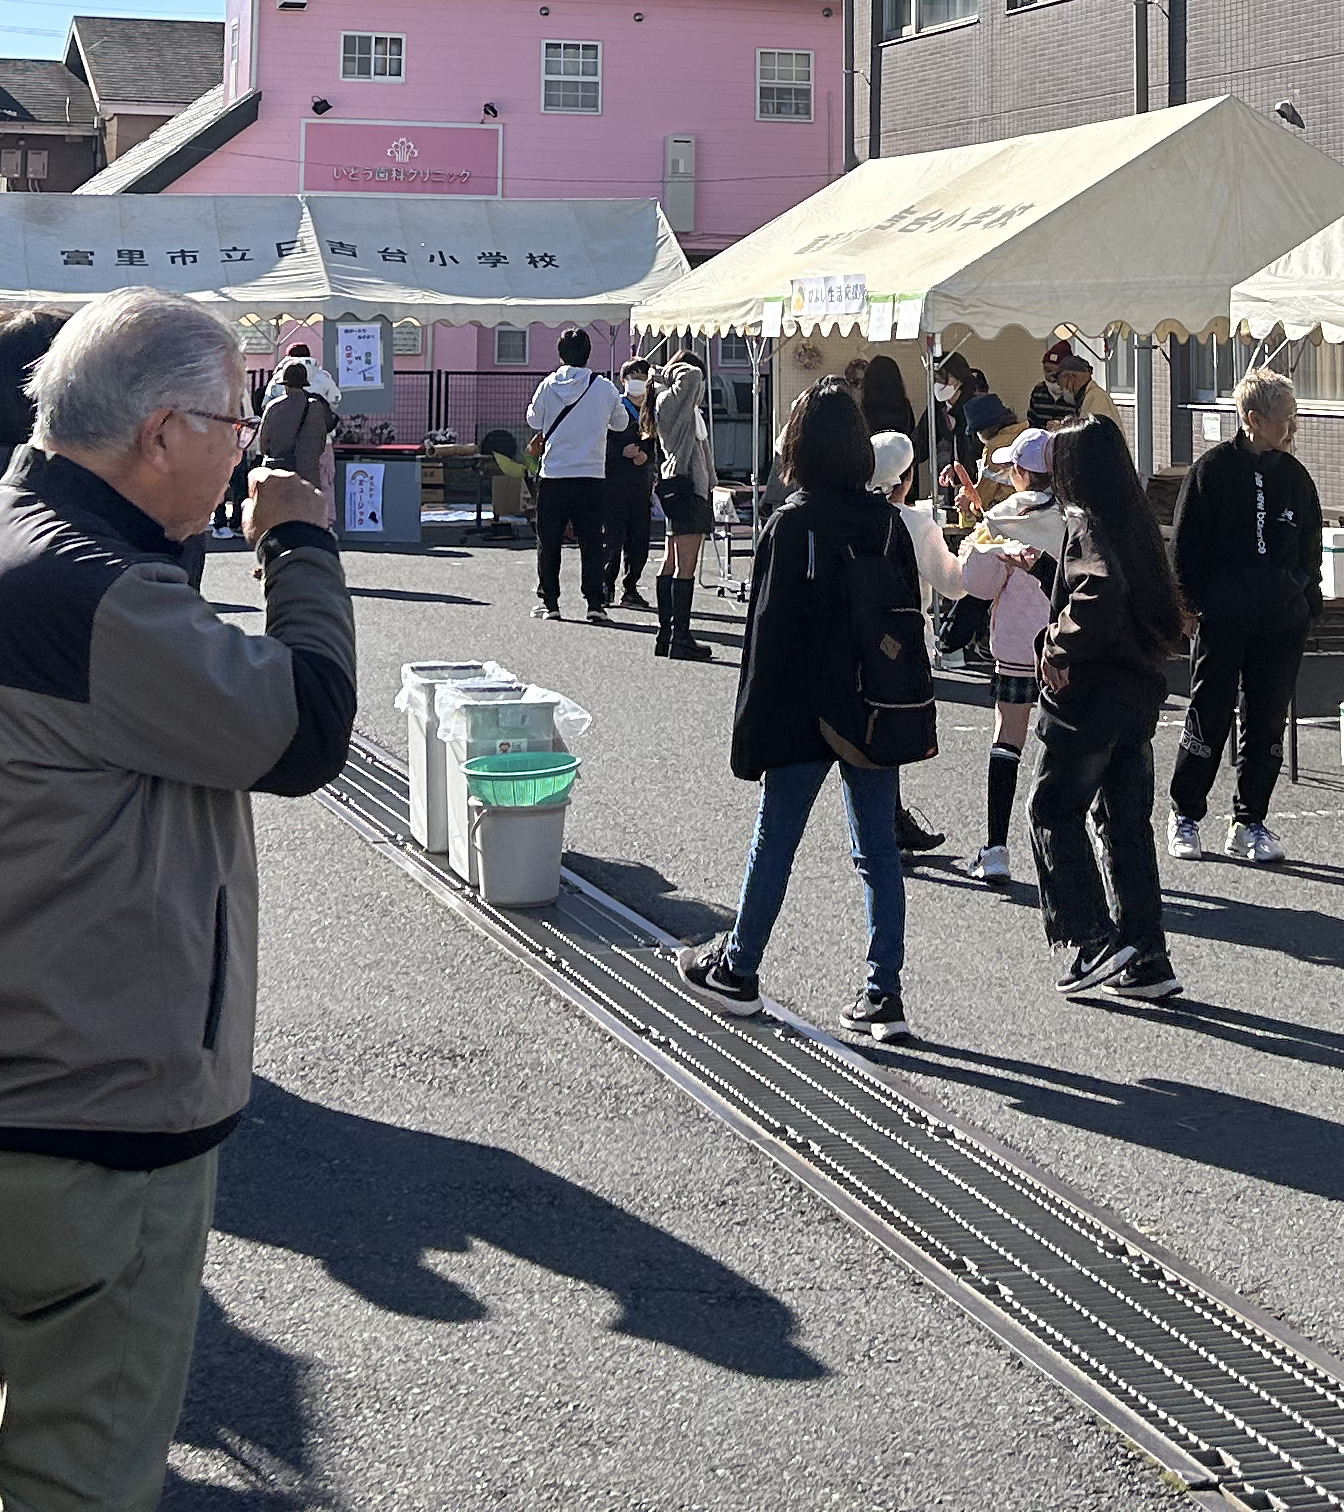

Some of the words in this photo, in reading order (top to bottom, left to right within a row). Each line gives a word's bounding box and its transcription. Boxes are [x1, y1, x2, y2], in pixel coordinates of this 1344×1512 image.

[333, 166, 472, 184] いとう歯科クリニック
[60, 238, 560, 269] 富里市立日吉台小学校
